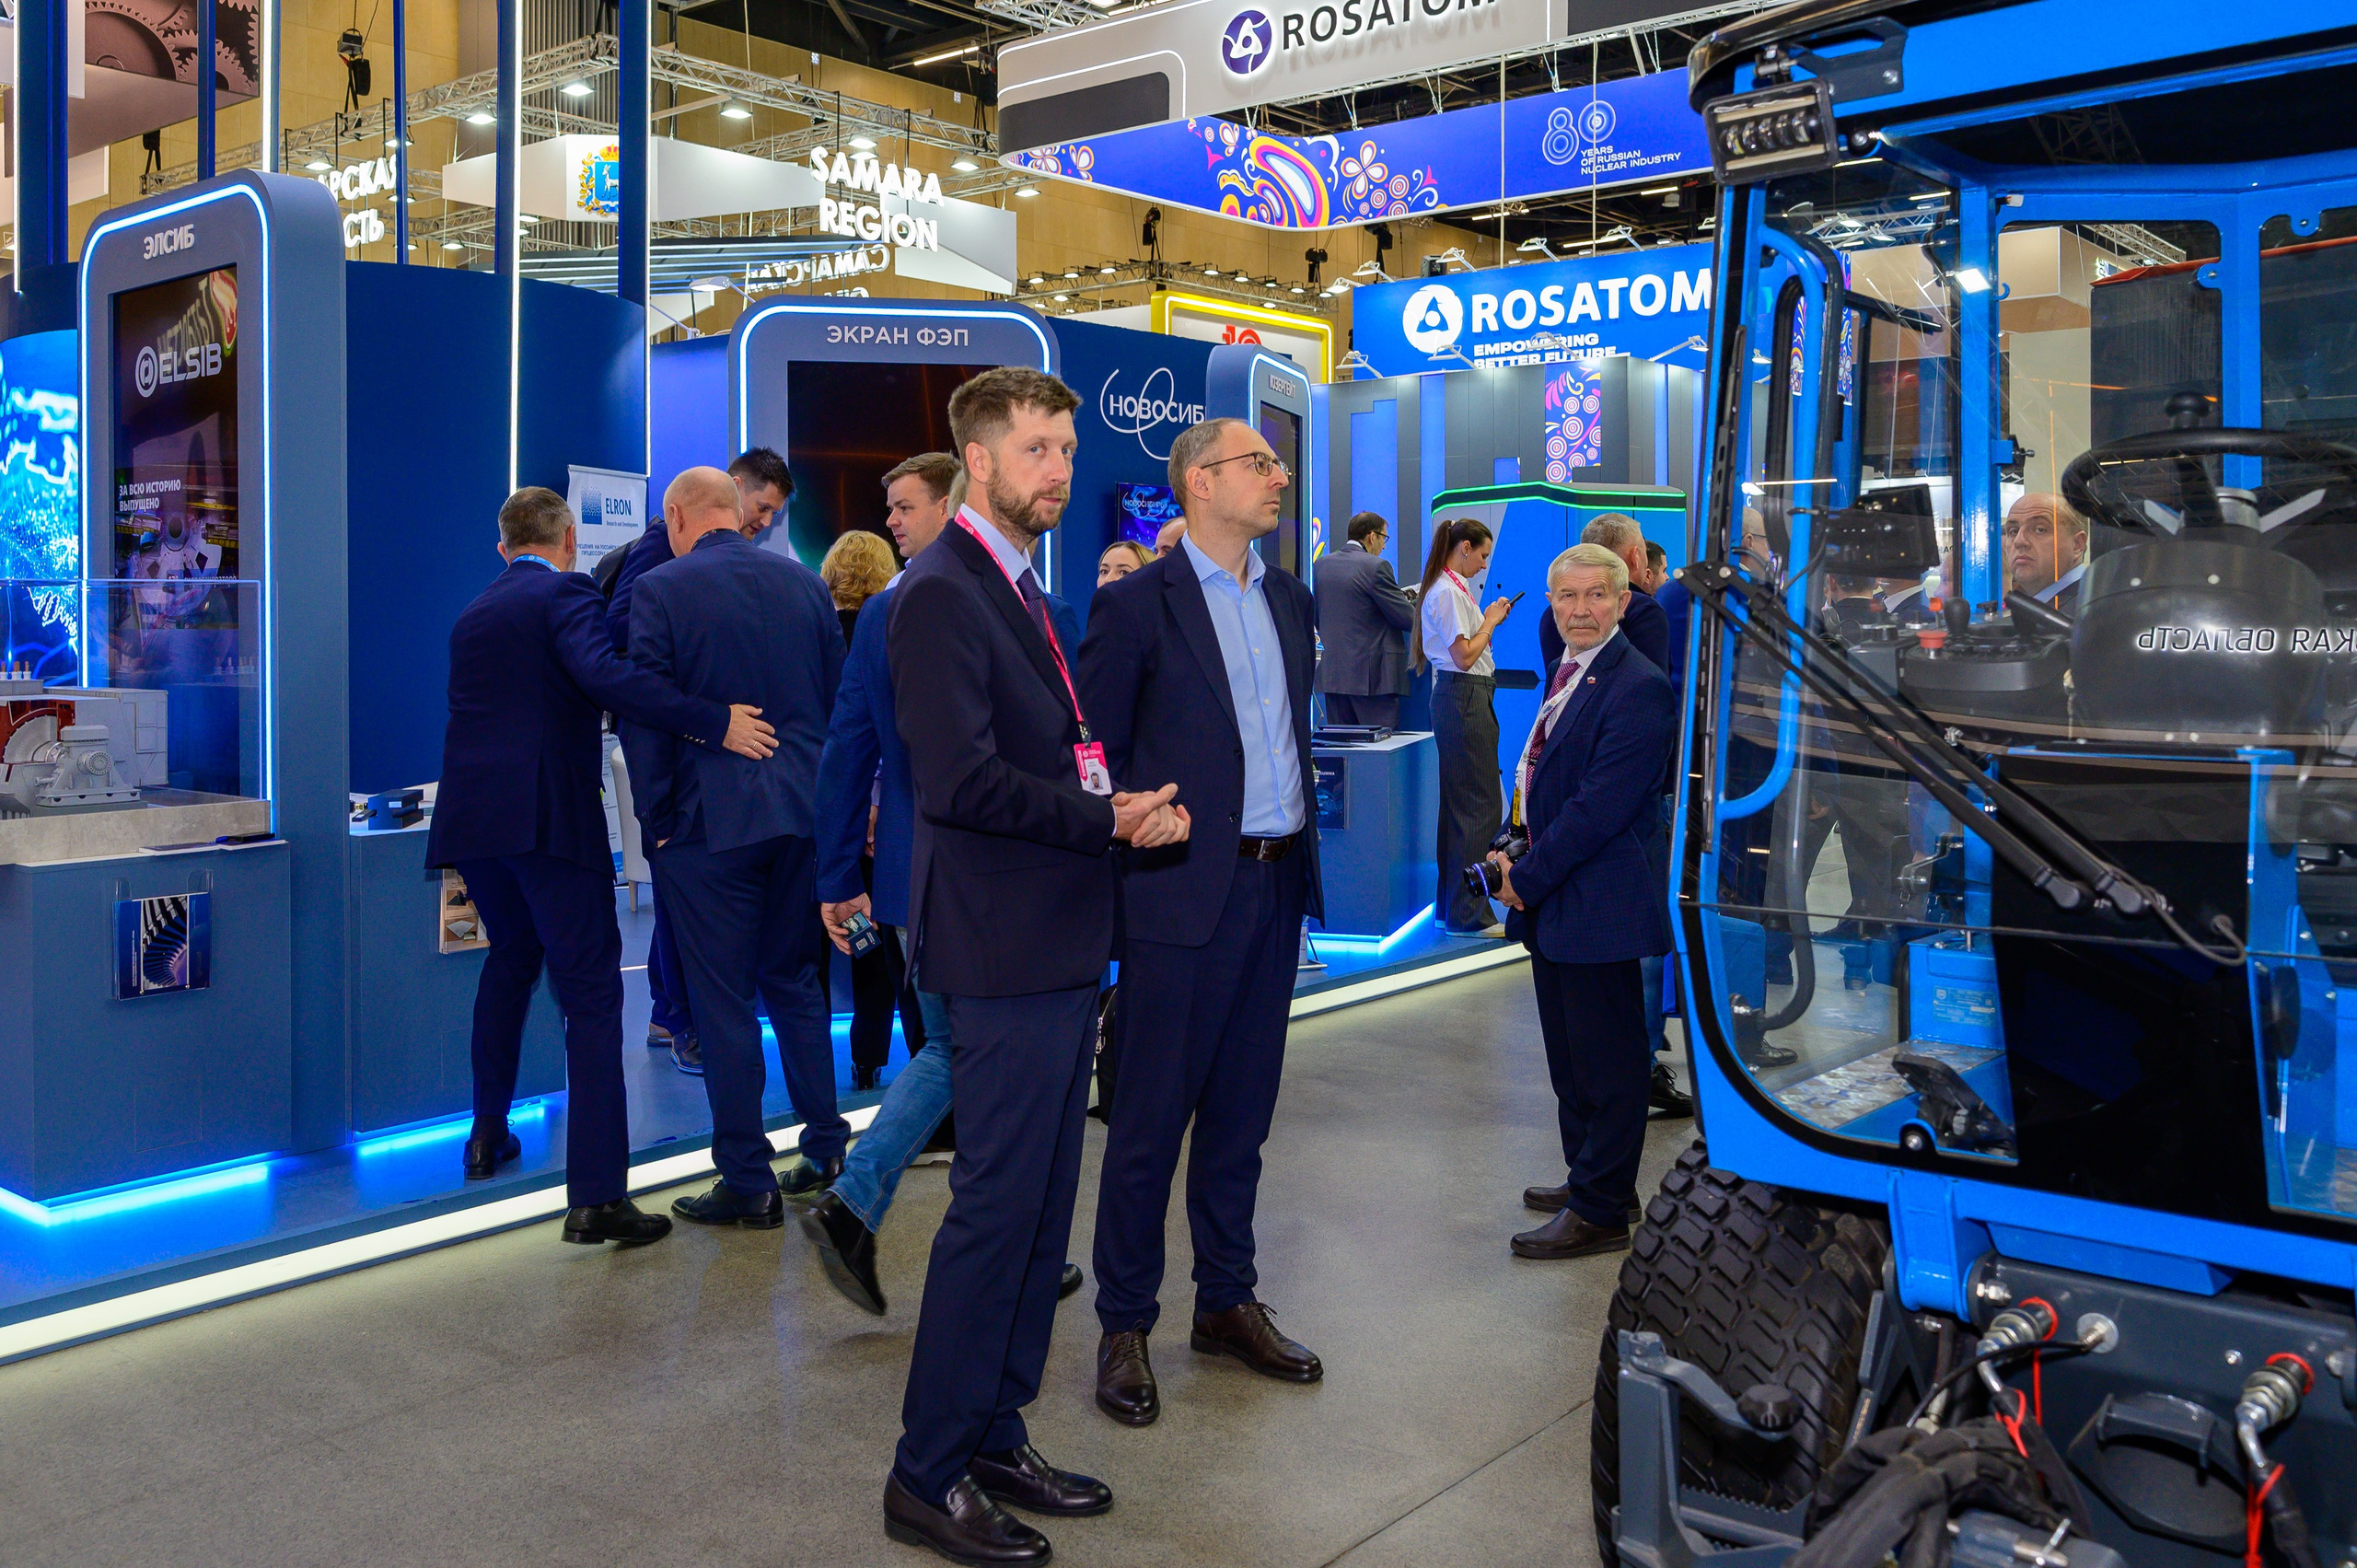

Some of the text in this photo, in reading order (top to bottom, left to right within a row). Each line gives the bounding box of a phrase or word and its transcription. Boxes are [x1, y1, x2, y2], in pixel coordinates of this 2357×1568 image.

[1580, 145, 1614, 157] YEARS
[1597, 149, 1641, 164] RUSSIAN
[1580, 152, 1681, 175] NUCLEAR INDUSTRY
[810, 145, 945, 206] SAMARA
[819, 198, 937, 252] REGION
[143, 224, 195, 260] ЭЛСИБ
[1471, 267, 1713, 333] ROSATOM
[827, 325, 969, 346] ЭКРАН ФЭП
[1473, 332, 1600, 357] EMPOWERING
[158, 343, 223, 385] ELSIB
[1473, 346, 1617, 369] BETTER FUTURE
[1109, 394, 1207, 424] НОВОСИБ
[119, 479, 181, 496] ЗА ВСЮ ИСТОРИЮ
[119, 497, 160, 512] ВЫПУЩЕНО
[605, 497, 632, 516] ELRON
